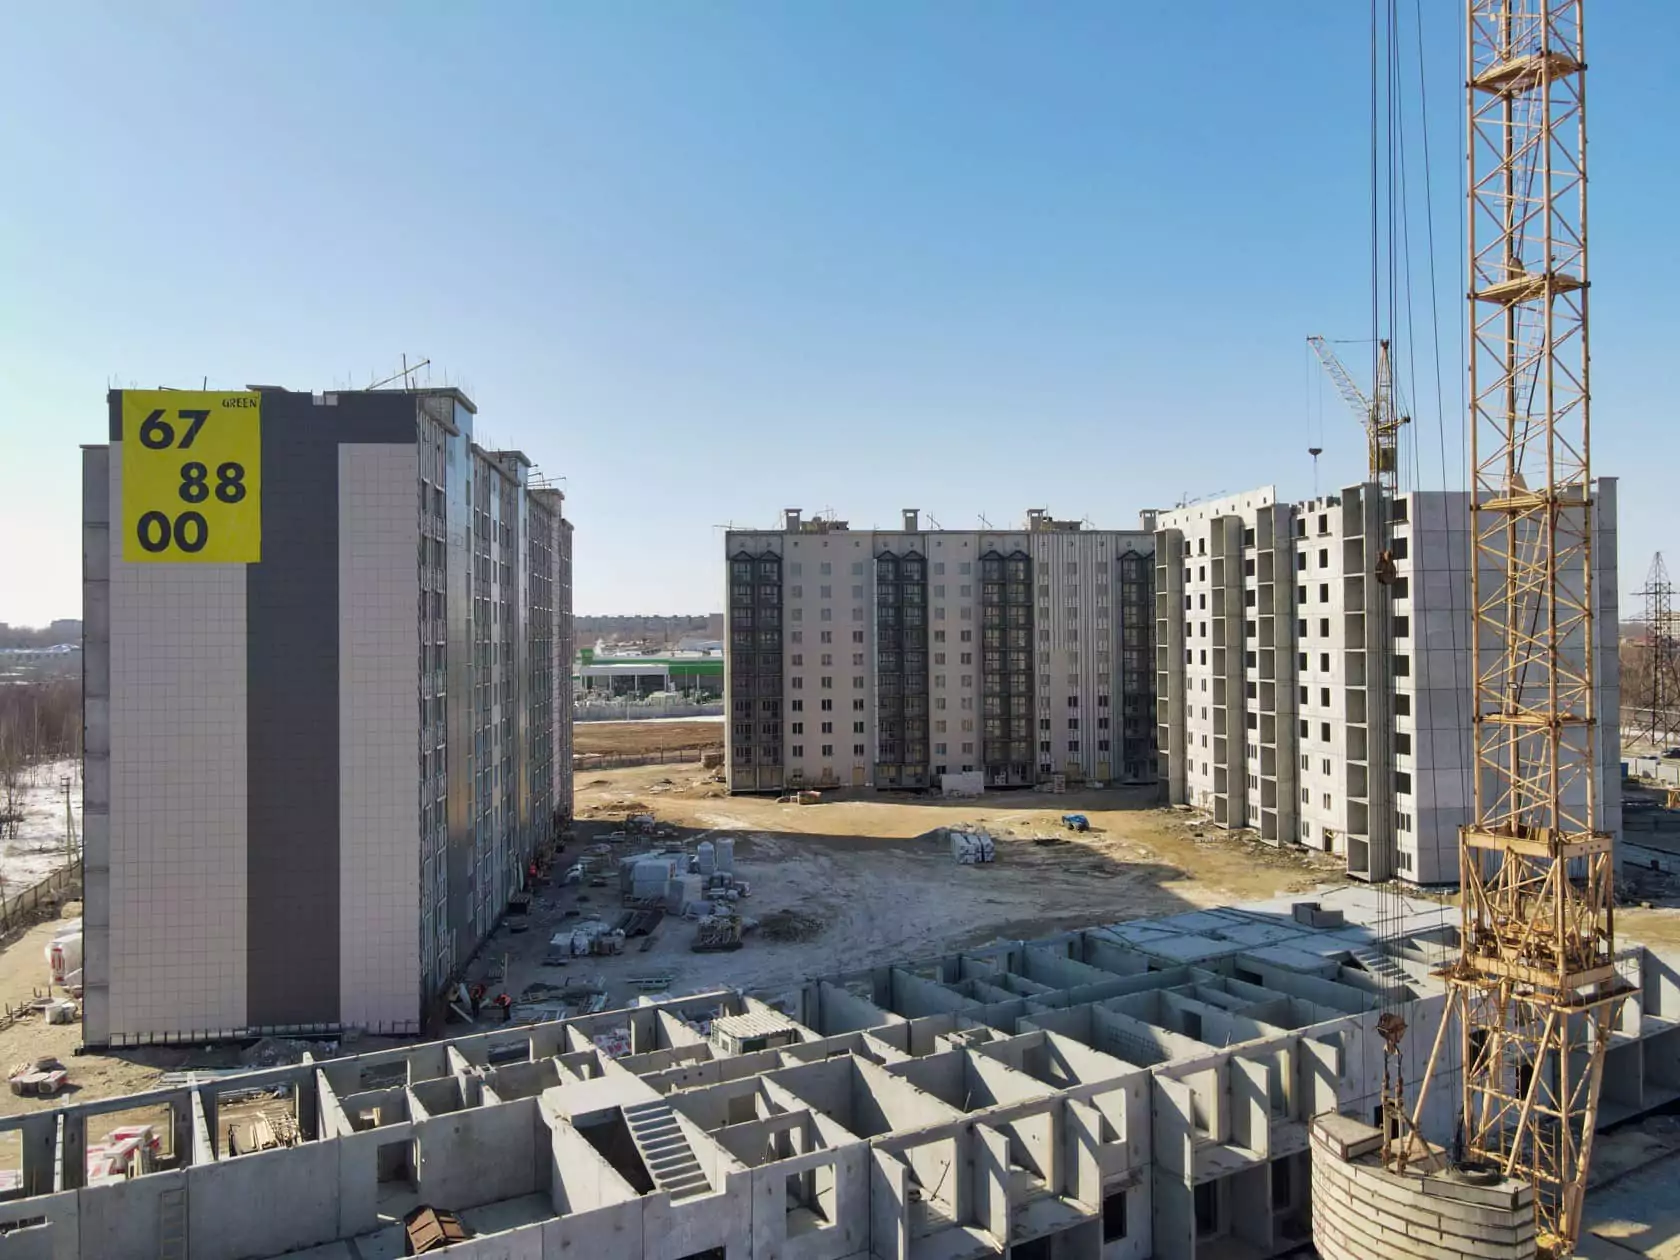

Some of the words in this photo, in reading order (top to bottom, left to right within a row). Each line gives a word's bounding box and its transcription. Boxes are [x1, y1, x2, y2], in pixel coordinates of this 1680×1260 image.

[222, 397, 257, 408] GREEN
[139, 409, 211, 450] 67
[178, 461, 246, 504] 88
[136, 510, 209, 553] 00
